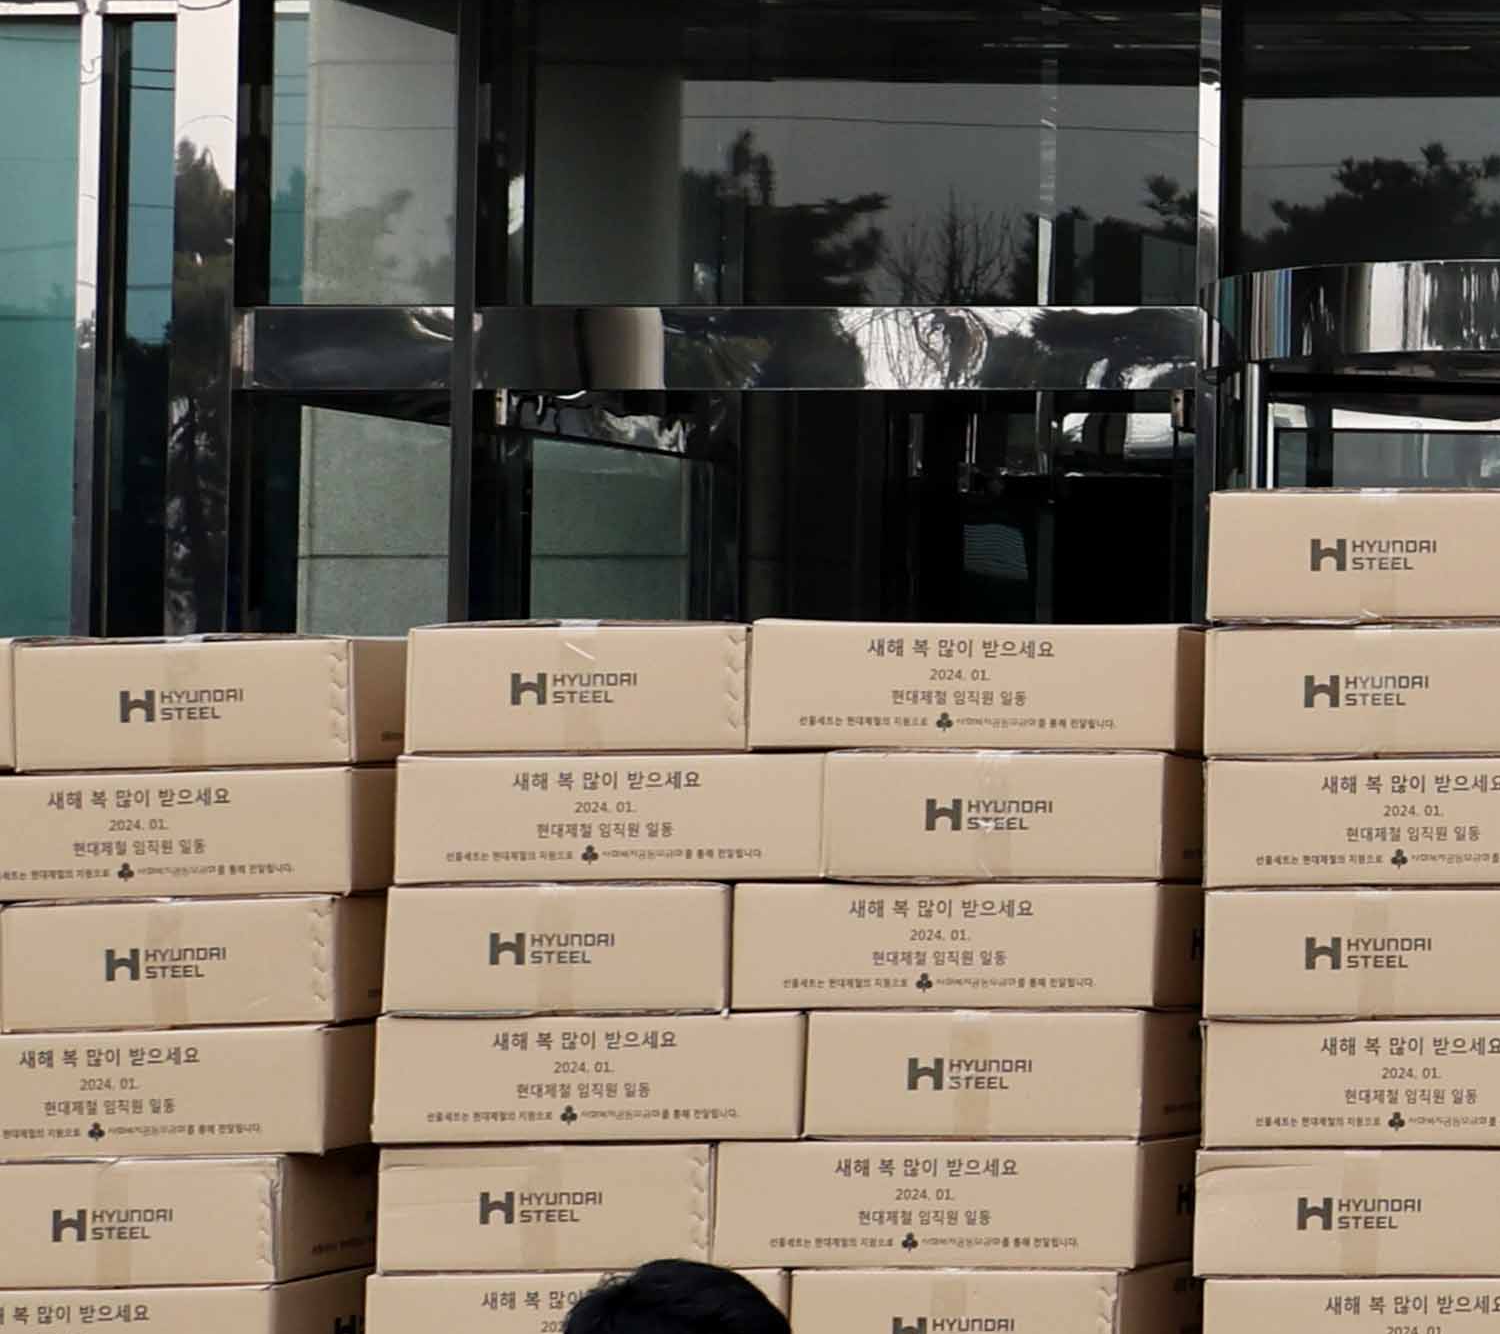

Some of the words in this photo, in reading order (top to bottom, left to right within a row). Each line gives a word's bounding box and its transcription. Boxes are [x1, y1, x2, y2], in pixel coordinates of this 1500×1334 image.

[1352, 540, 1436, 553] HYUNDAI
[1352, 557, 1413, 570] STEEL
[553, 673, 636, 686] HYUNDAI
[161, 689, 242, 703] HYUNDAI
[553, 691, 613, 703] STEEL
[162, 707, 220, 720] STEEL
[48, 791, 82, 809] 새해
[91, 791, 106, 808] 복
[116, 790, 149, 808] 많이
[159, 788, 230, 807] 받으세요
[109, 819, 144, 831] 2024.
[149, 819, 168, 830] 01.
[73, 841, 126, 857] 현대제철
[133, 840, 172, 855] 임직원
[179, 839, 205, 854] 일동
